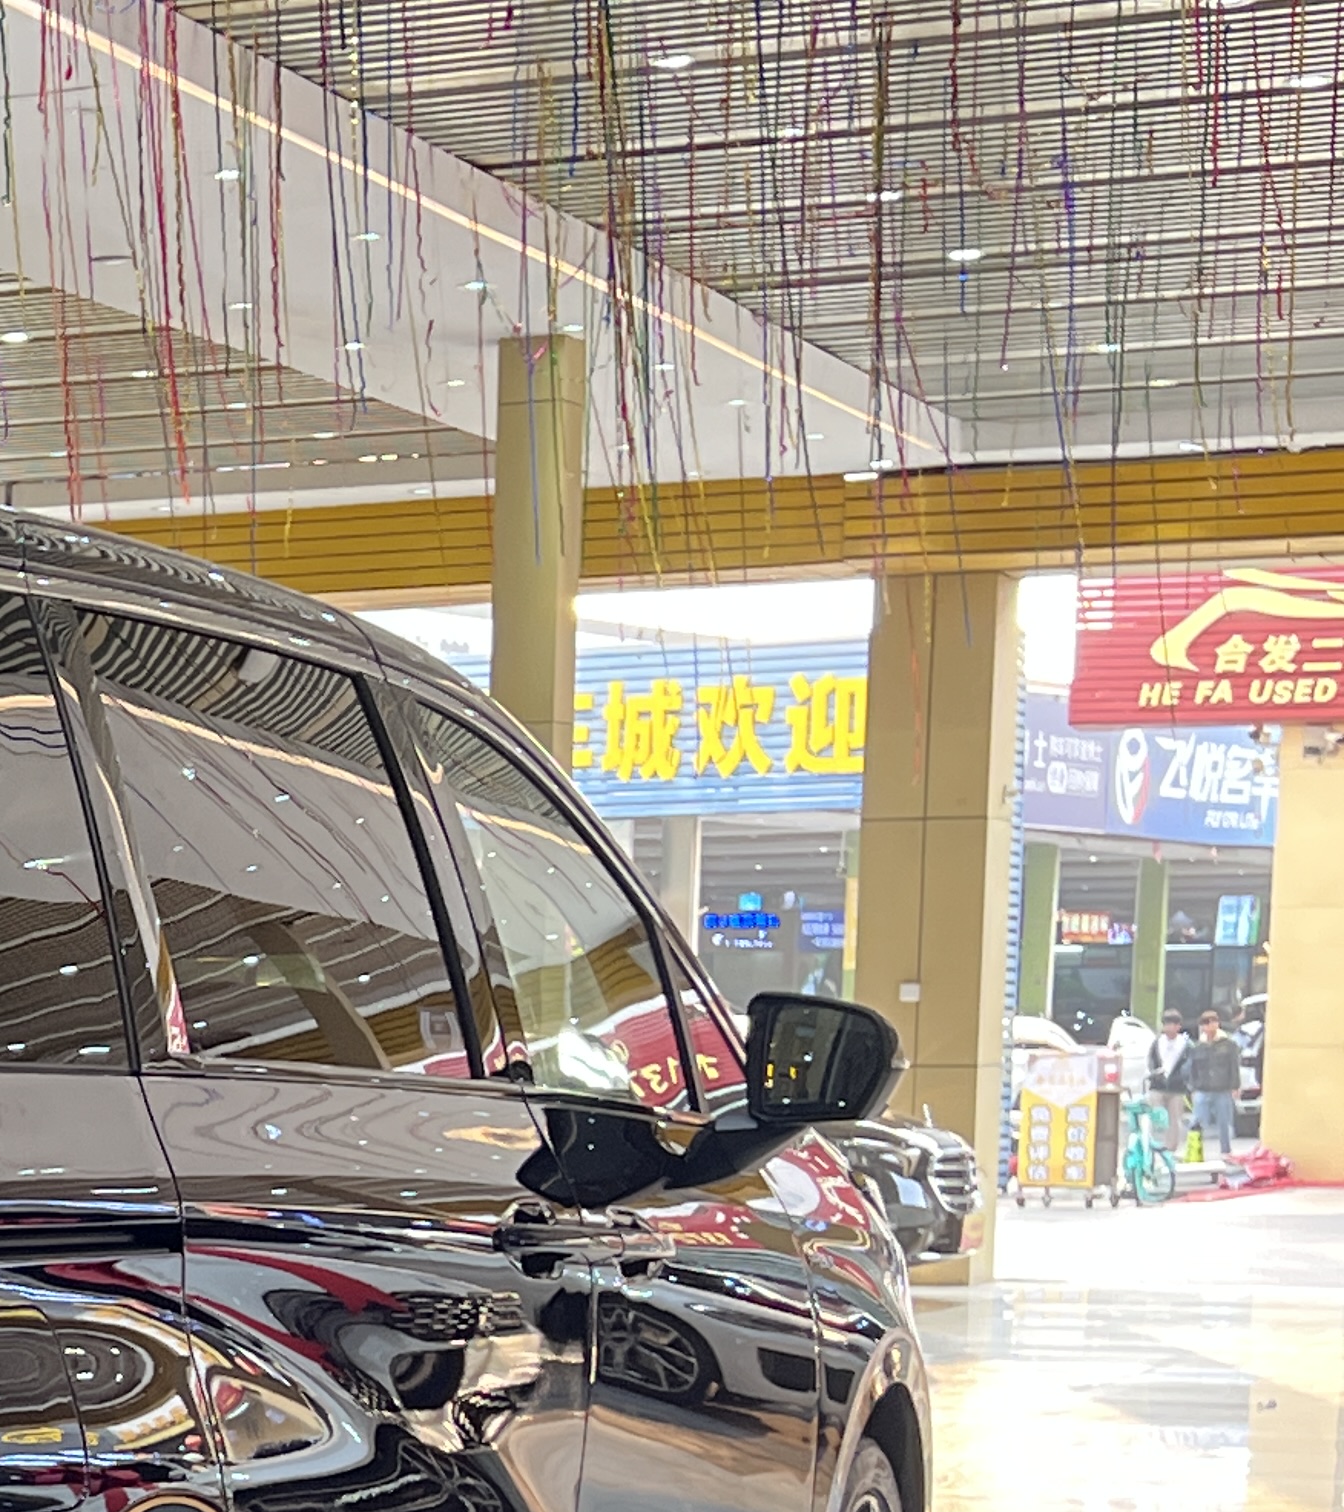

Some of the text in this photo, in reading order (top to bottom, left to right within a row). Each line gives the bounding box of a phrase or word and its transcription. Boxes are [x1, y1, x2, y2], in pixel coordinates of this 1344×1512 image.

[1137, 677, 1339, 708] HE FA USED
